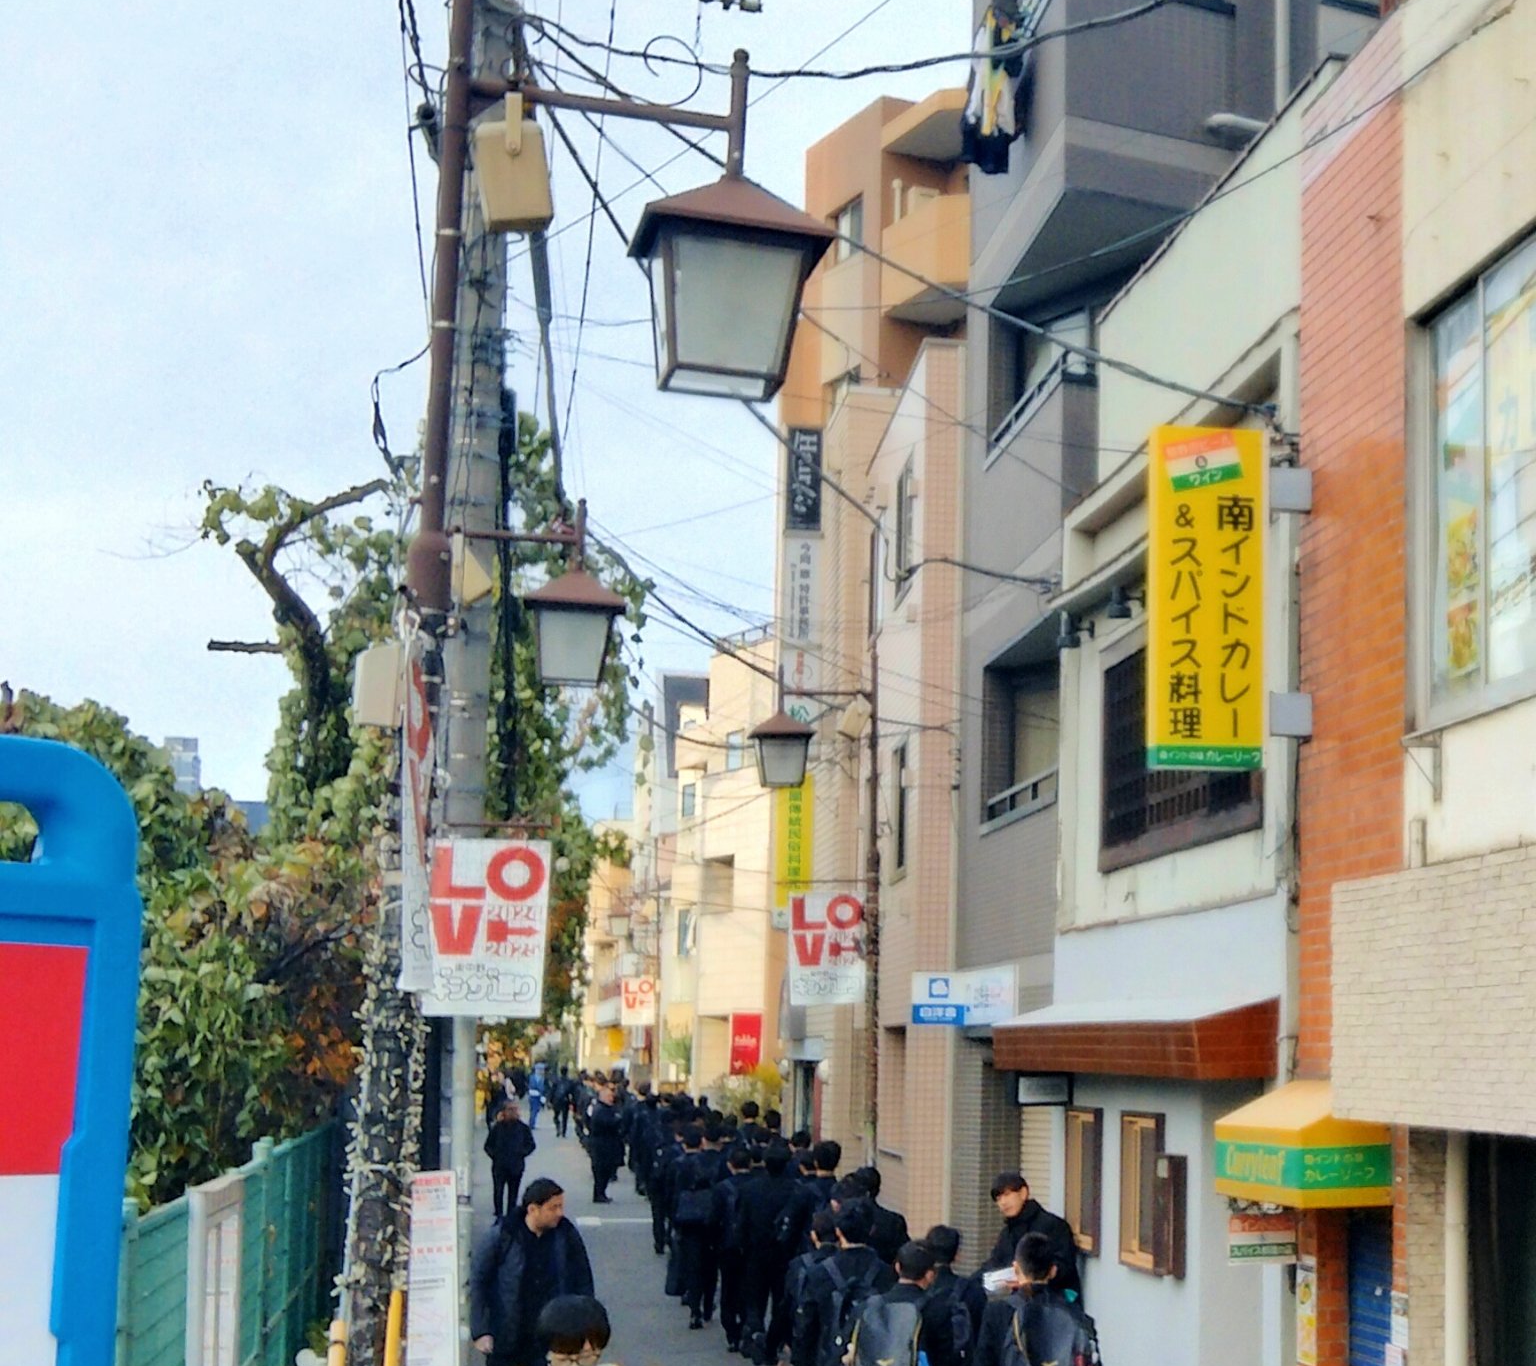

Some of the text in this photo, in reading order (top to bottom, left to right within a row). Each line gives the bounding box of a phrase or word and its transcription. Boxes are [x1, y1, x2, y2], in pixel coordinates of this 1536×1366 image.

[1189, 469, 1223, 486] ワイン
[1168, 503, 1203, 739] &スパイス料理
[1217, 494, 1255, 738] 南インドカレー
[1206, 746, 1261, 763] カレーリーフ
[1303, 1166, 1376, 1182] カレーリーフ
